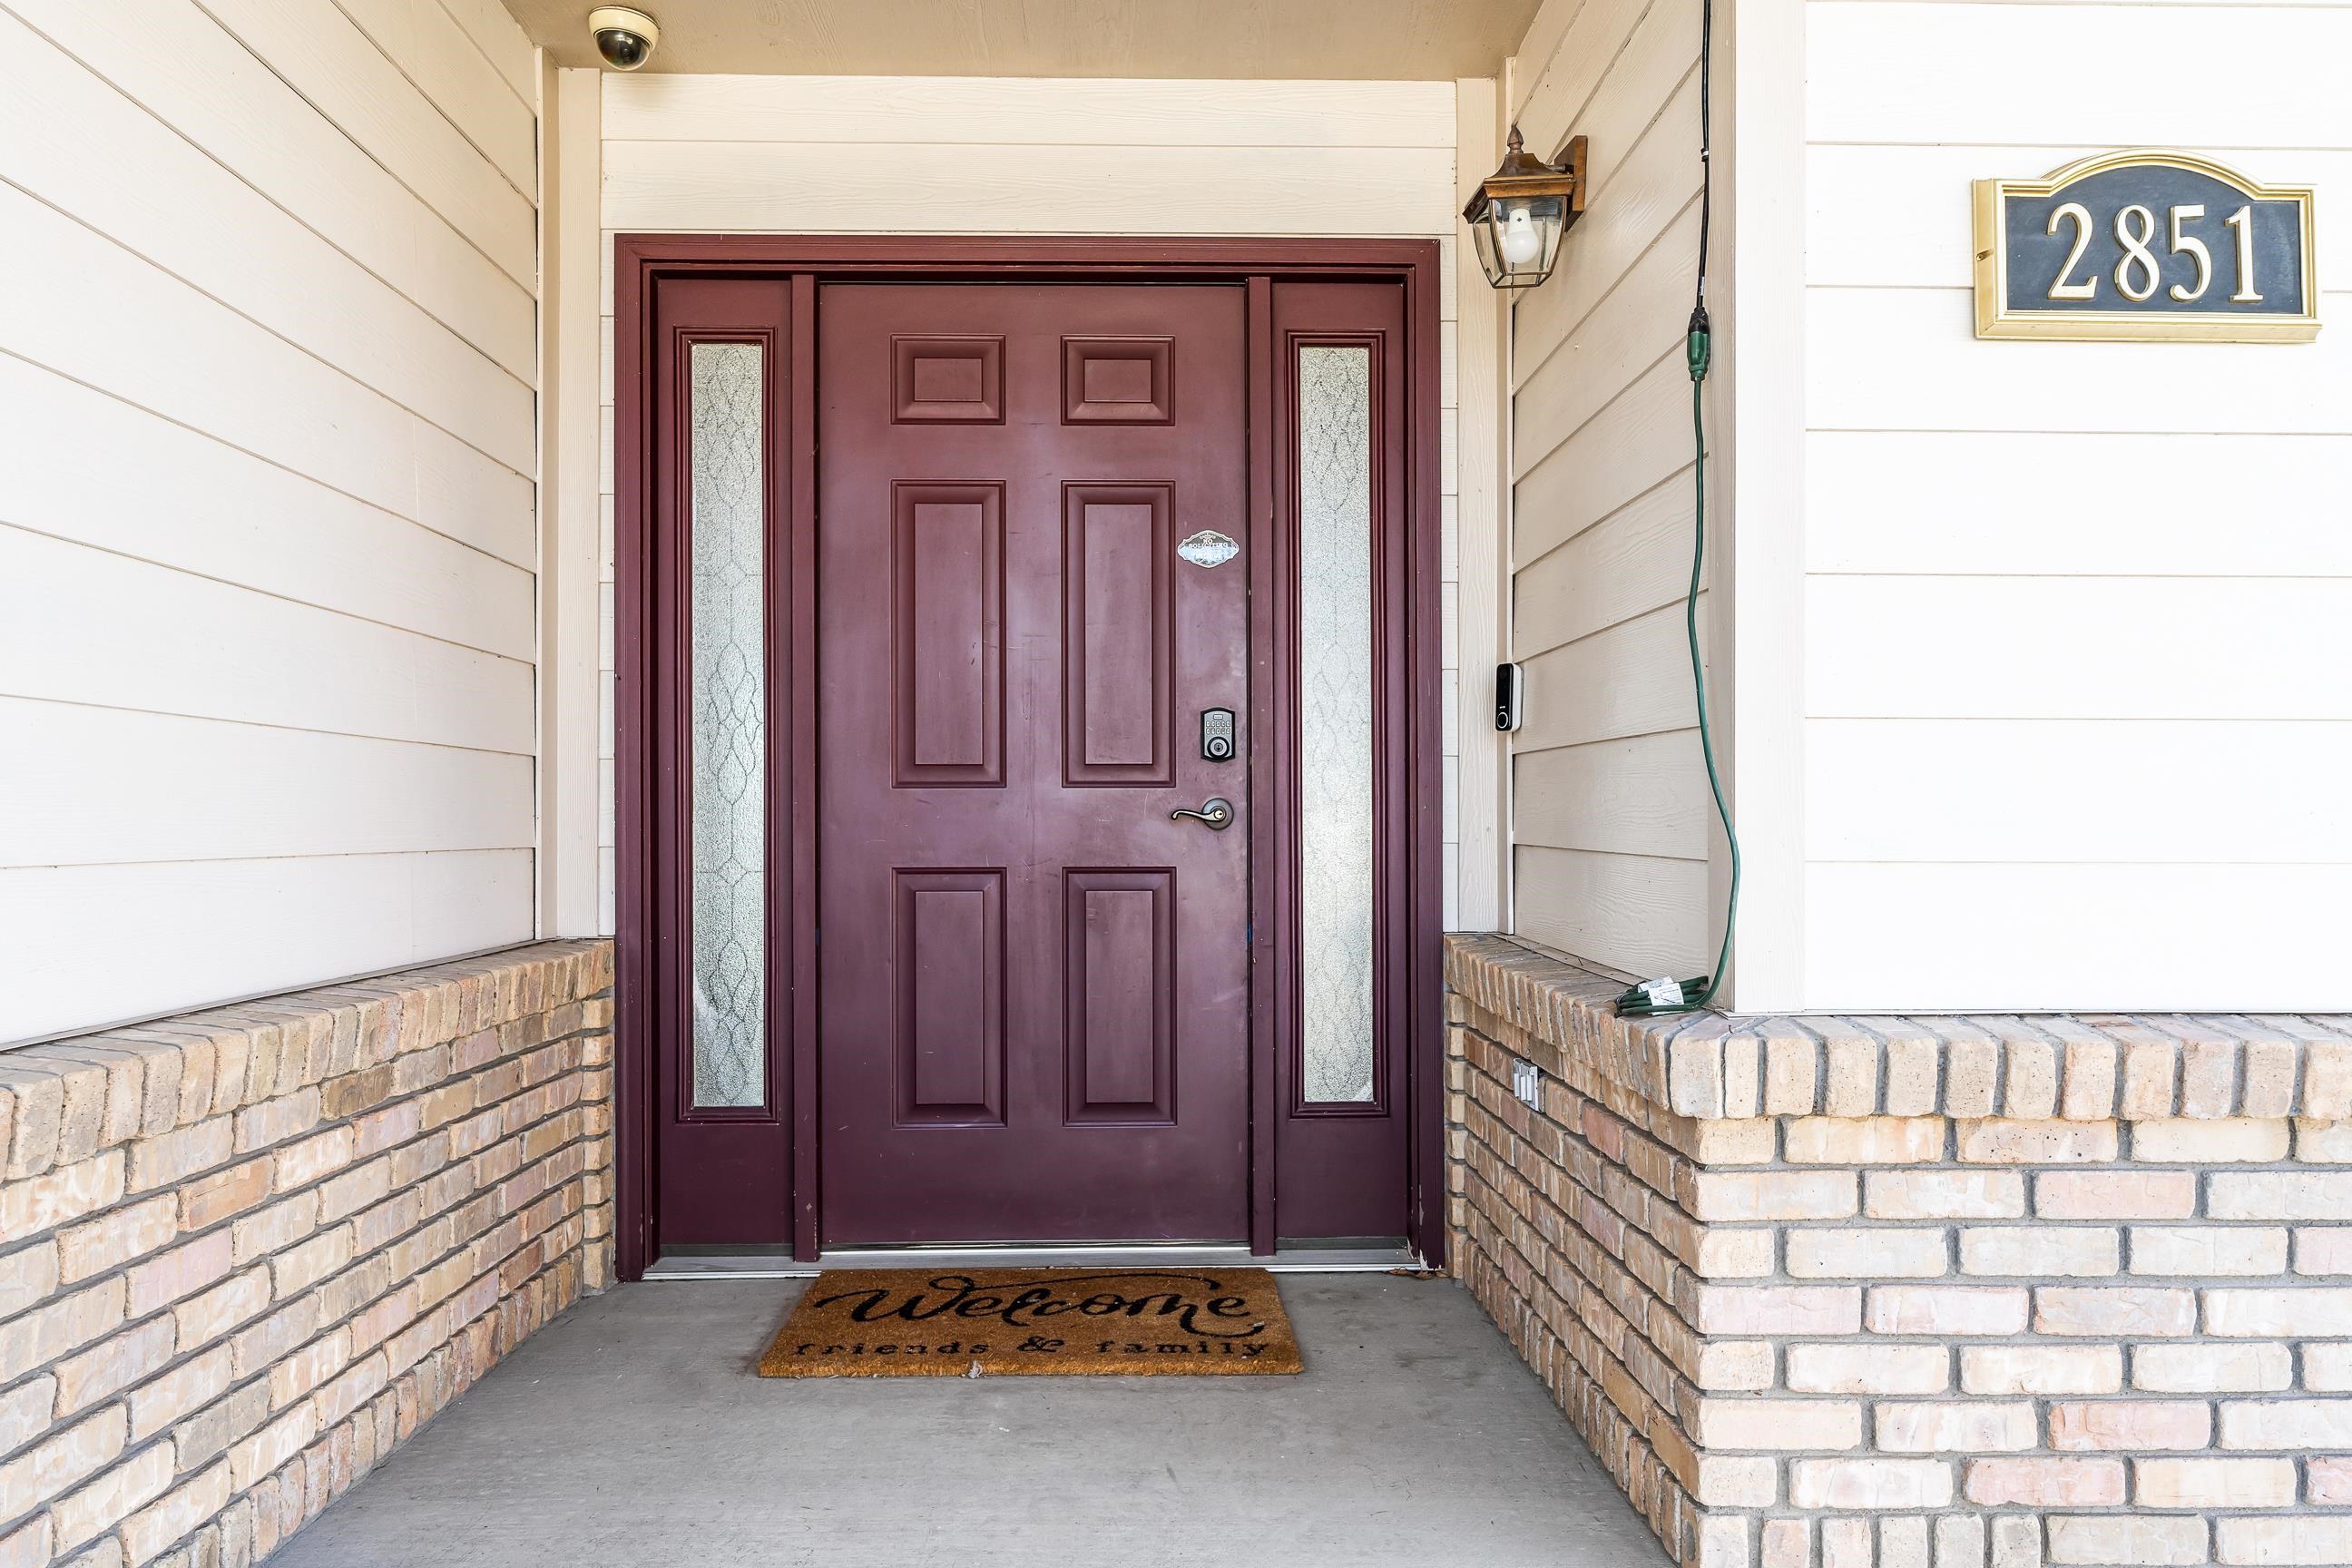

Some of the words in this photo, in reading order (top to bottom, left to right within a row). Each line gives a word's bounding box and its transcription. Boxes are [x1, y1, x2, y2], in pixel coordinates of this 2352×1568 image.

[2046, 201, 2265, 304] 2851
[816, 1272, 1265, 1338] Welcome
[794, 1341, 989, 1355] friends
[1016, 1336, 1065, 1353] &
[1095, 1340, 1269, 1357] family
